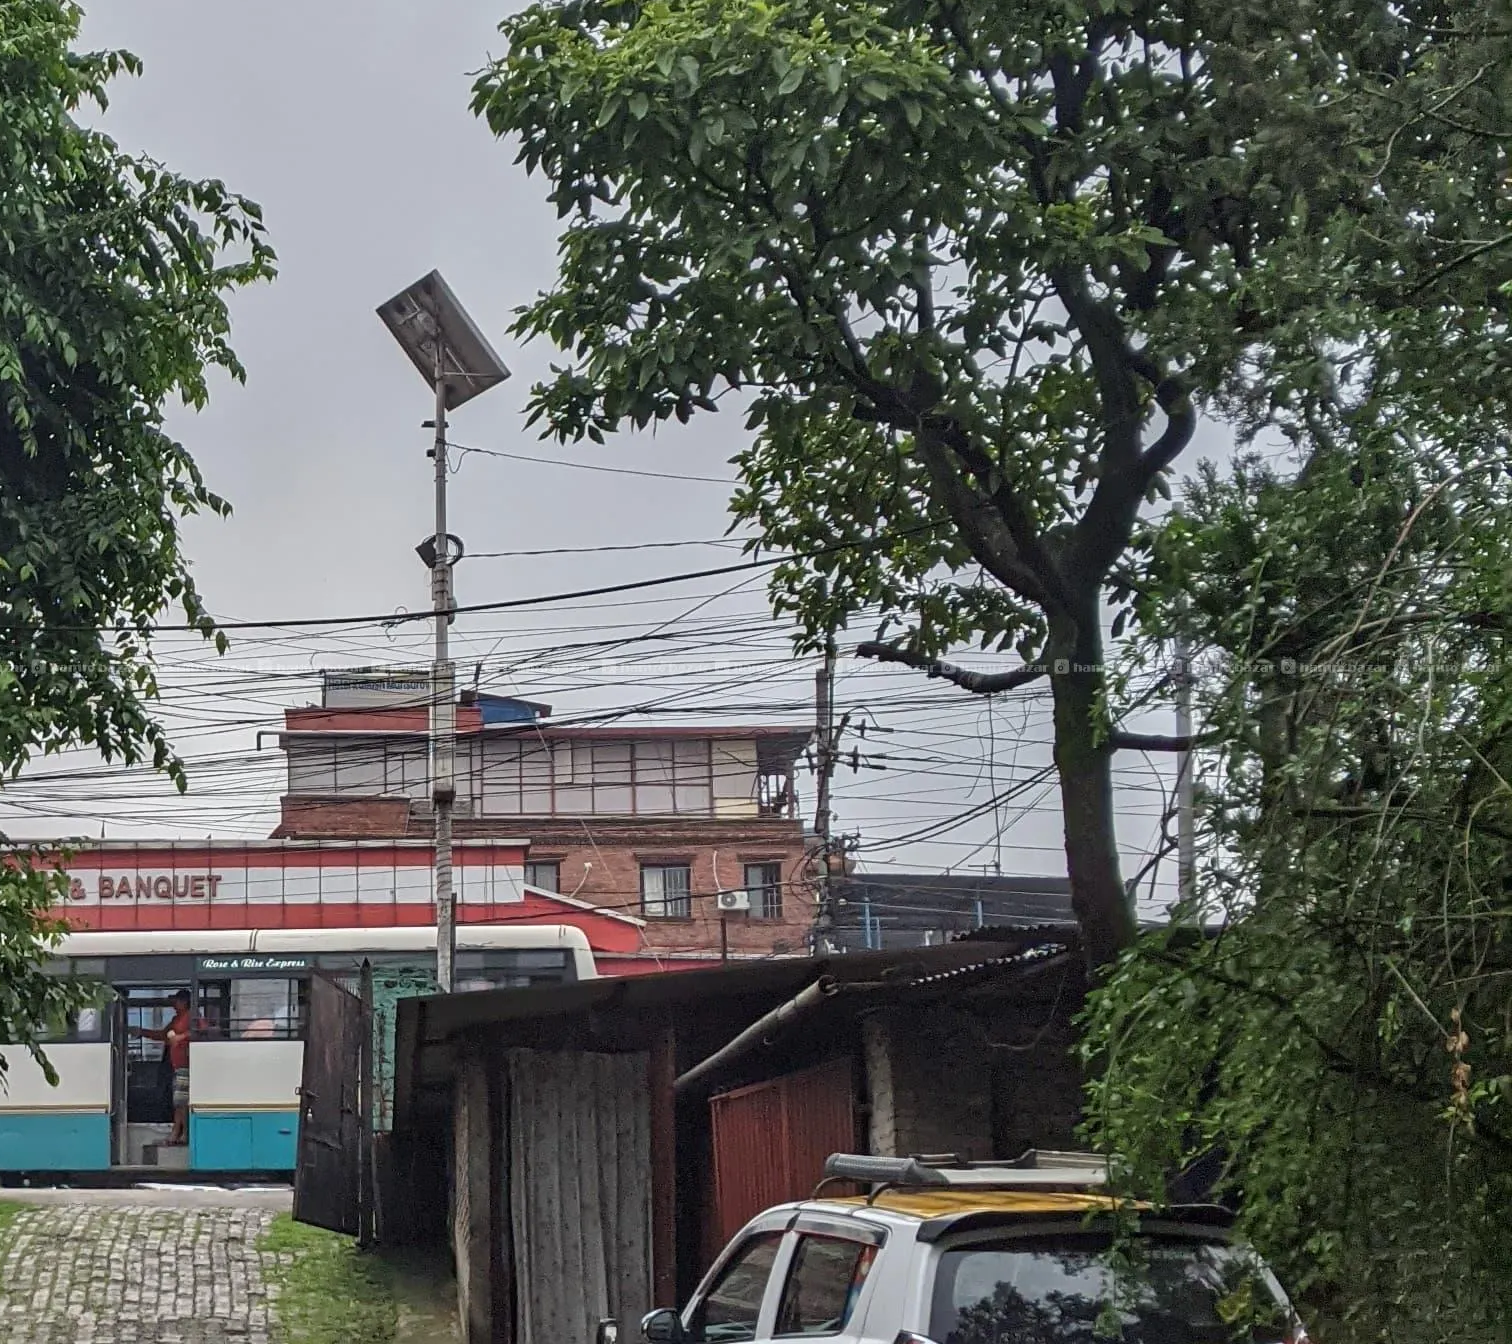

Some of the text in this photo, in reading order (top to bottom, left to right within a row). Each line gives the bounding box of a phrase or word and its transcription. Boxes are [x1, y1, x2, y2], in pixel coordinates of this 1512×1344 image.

[70, 877, 87, 900] &
[98, 874, 223, 899] BANQUET
[203, 959, 229, 968] Rose
[231, 959, 239, 968] &
[266, 958, 305, 968] Express
